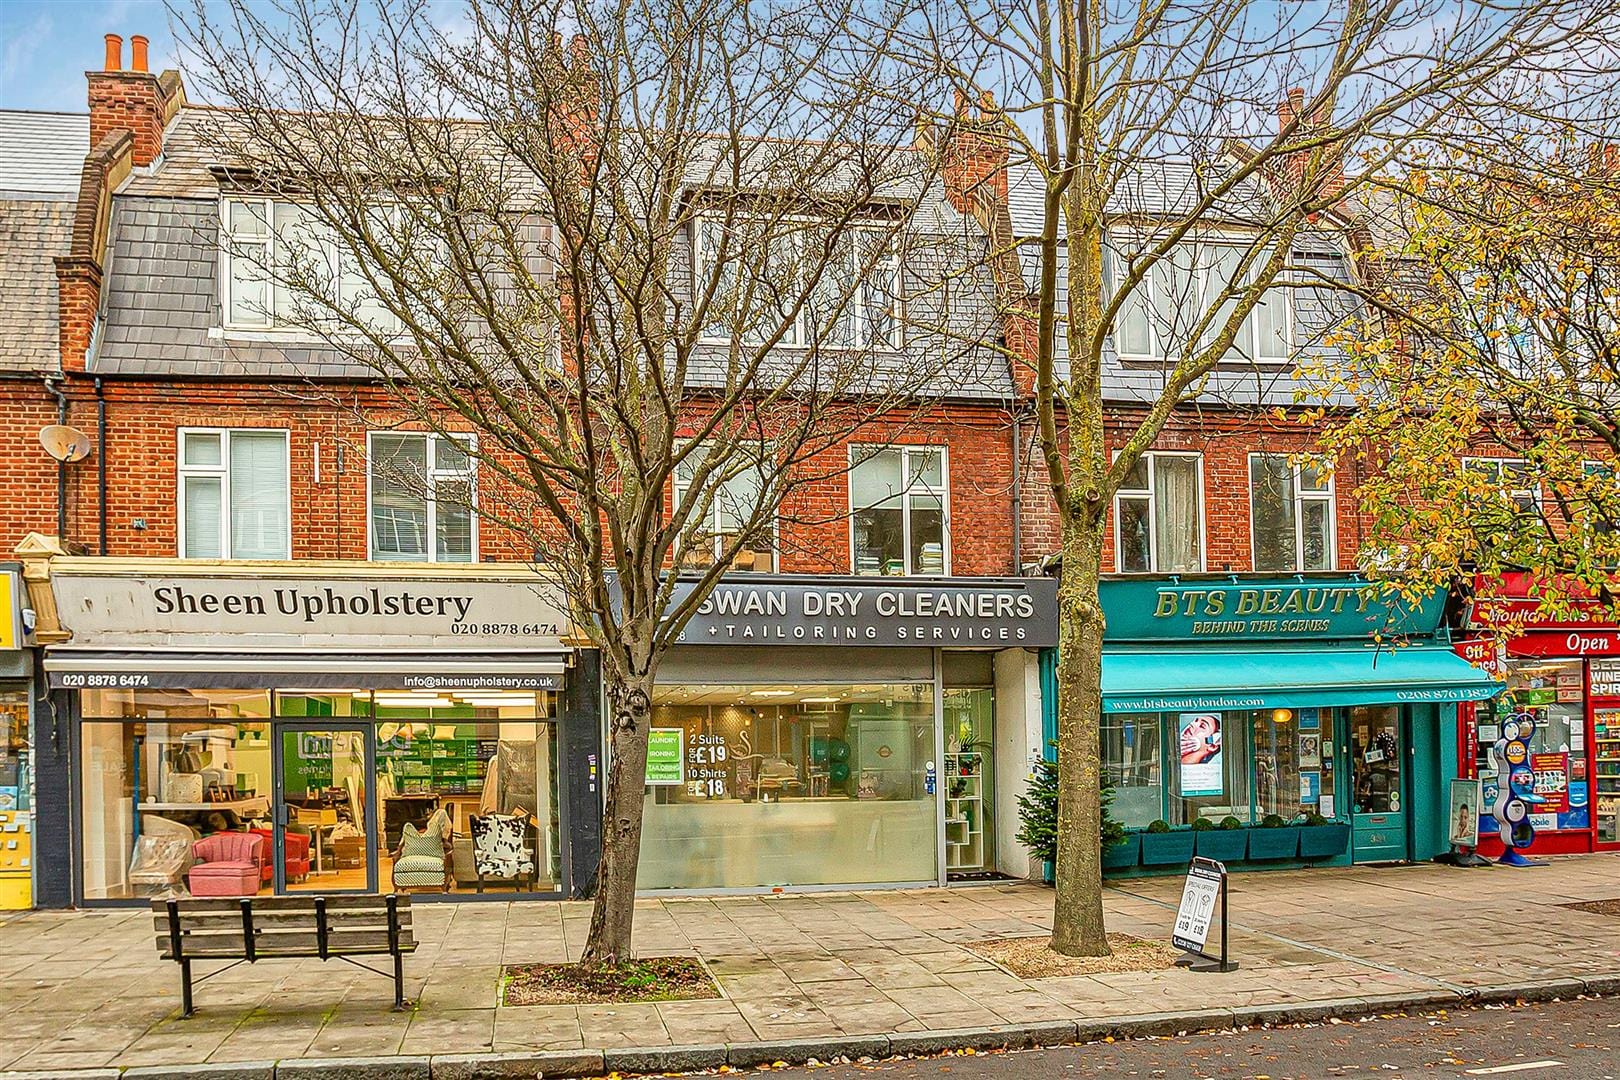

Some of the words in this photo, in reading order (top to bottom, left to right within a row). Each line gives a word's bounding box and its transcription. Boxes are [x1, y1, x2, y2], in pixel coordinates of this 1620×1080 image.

[154, 586, 267, 615] Sheen
[274, 588, 474, 622] Upholstery
[697, 590, 787, 616] SWAN
[803, 591, 864, 616] DRY
[876, 592, 1035, 618] CLEANERS
[1153, 590, 1227, 617] BTS
[1234, 588, 1373, 615] BEAUTY
[451, 624, 479, 635] 020
[482, 624, 519, 635] 8878
[522, 624, 559, 635] 6474
[1192, 621, 1247, 634] BEHIND
[1250, 620, 1277, 633] THE
[1280, 619, 1331, 632] SCENES
[897, 627, 1027, 640] SERVICES
[1566, 633, 1609, 654] Open
[62, 675, 85, 686] 020
[88, 675, 117, 686] 8878
[119, 675, 149, 686] 6474
[404, 676, 553, 688] info@sheenupholstery.co.uk
[1396, 691, 1431, 700] 0208
[1433, 690, 1457, 699] 876
[1460, 688, 1489, 698] 1382
[1112, 697, 1265, 709] www.btsbeautylondon.com
[689, 734, 697, 745] 2
[698, 734, 725, 745] Suits
[696, 746, 726, 764] £19
[687, 769, 698, 778] 10
[699, 769, 727, 778] Shirts
[695, 779, 724, 797] £18
